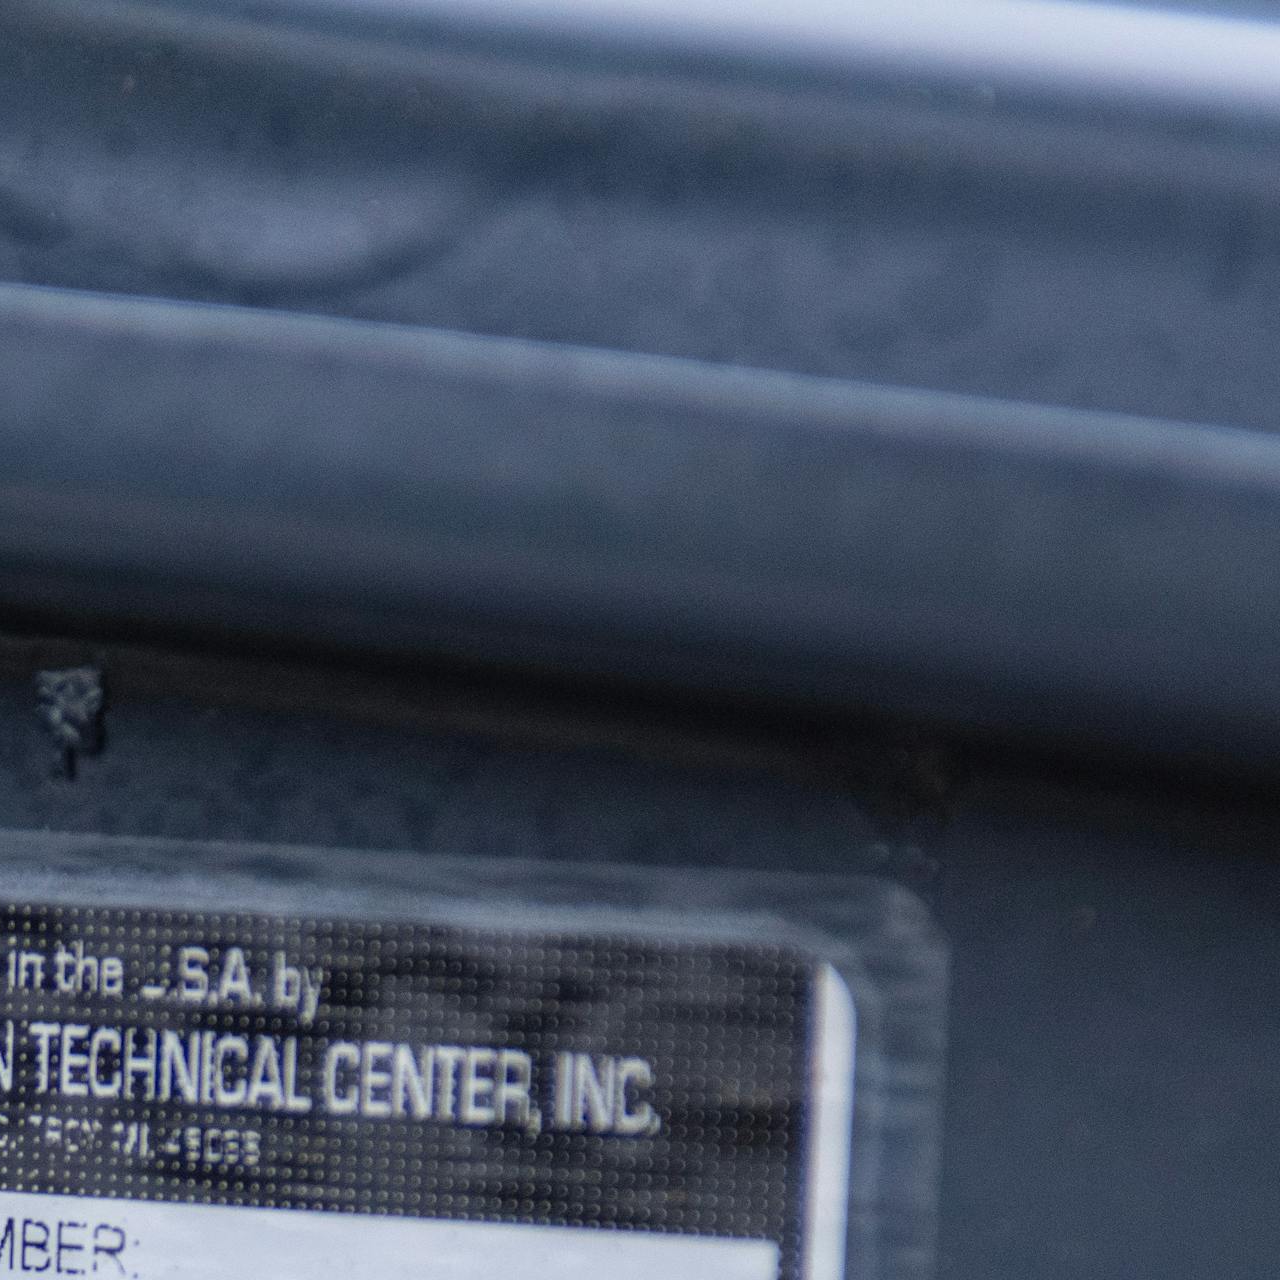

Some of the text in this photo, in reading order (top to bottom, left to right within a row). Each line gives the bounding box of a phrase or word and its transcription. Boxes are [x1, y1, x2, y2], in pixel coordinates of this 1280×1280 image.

[8, 949, 45, 989] in
[54, 941, 124, 996] the
[140, 946, 265, 1004] .S.A.
[272, 950, 322, 1024] by
[28, 1021, 312, 1112] TECHNICAL
[324, 1041, 544, 1137] CENTER,
[555, 1052, 662, 1136] INC.
